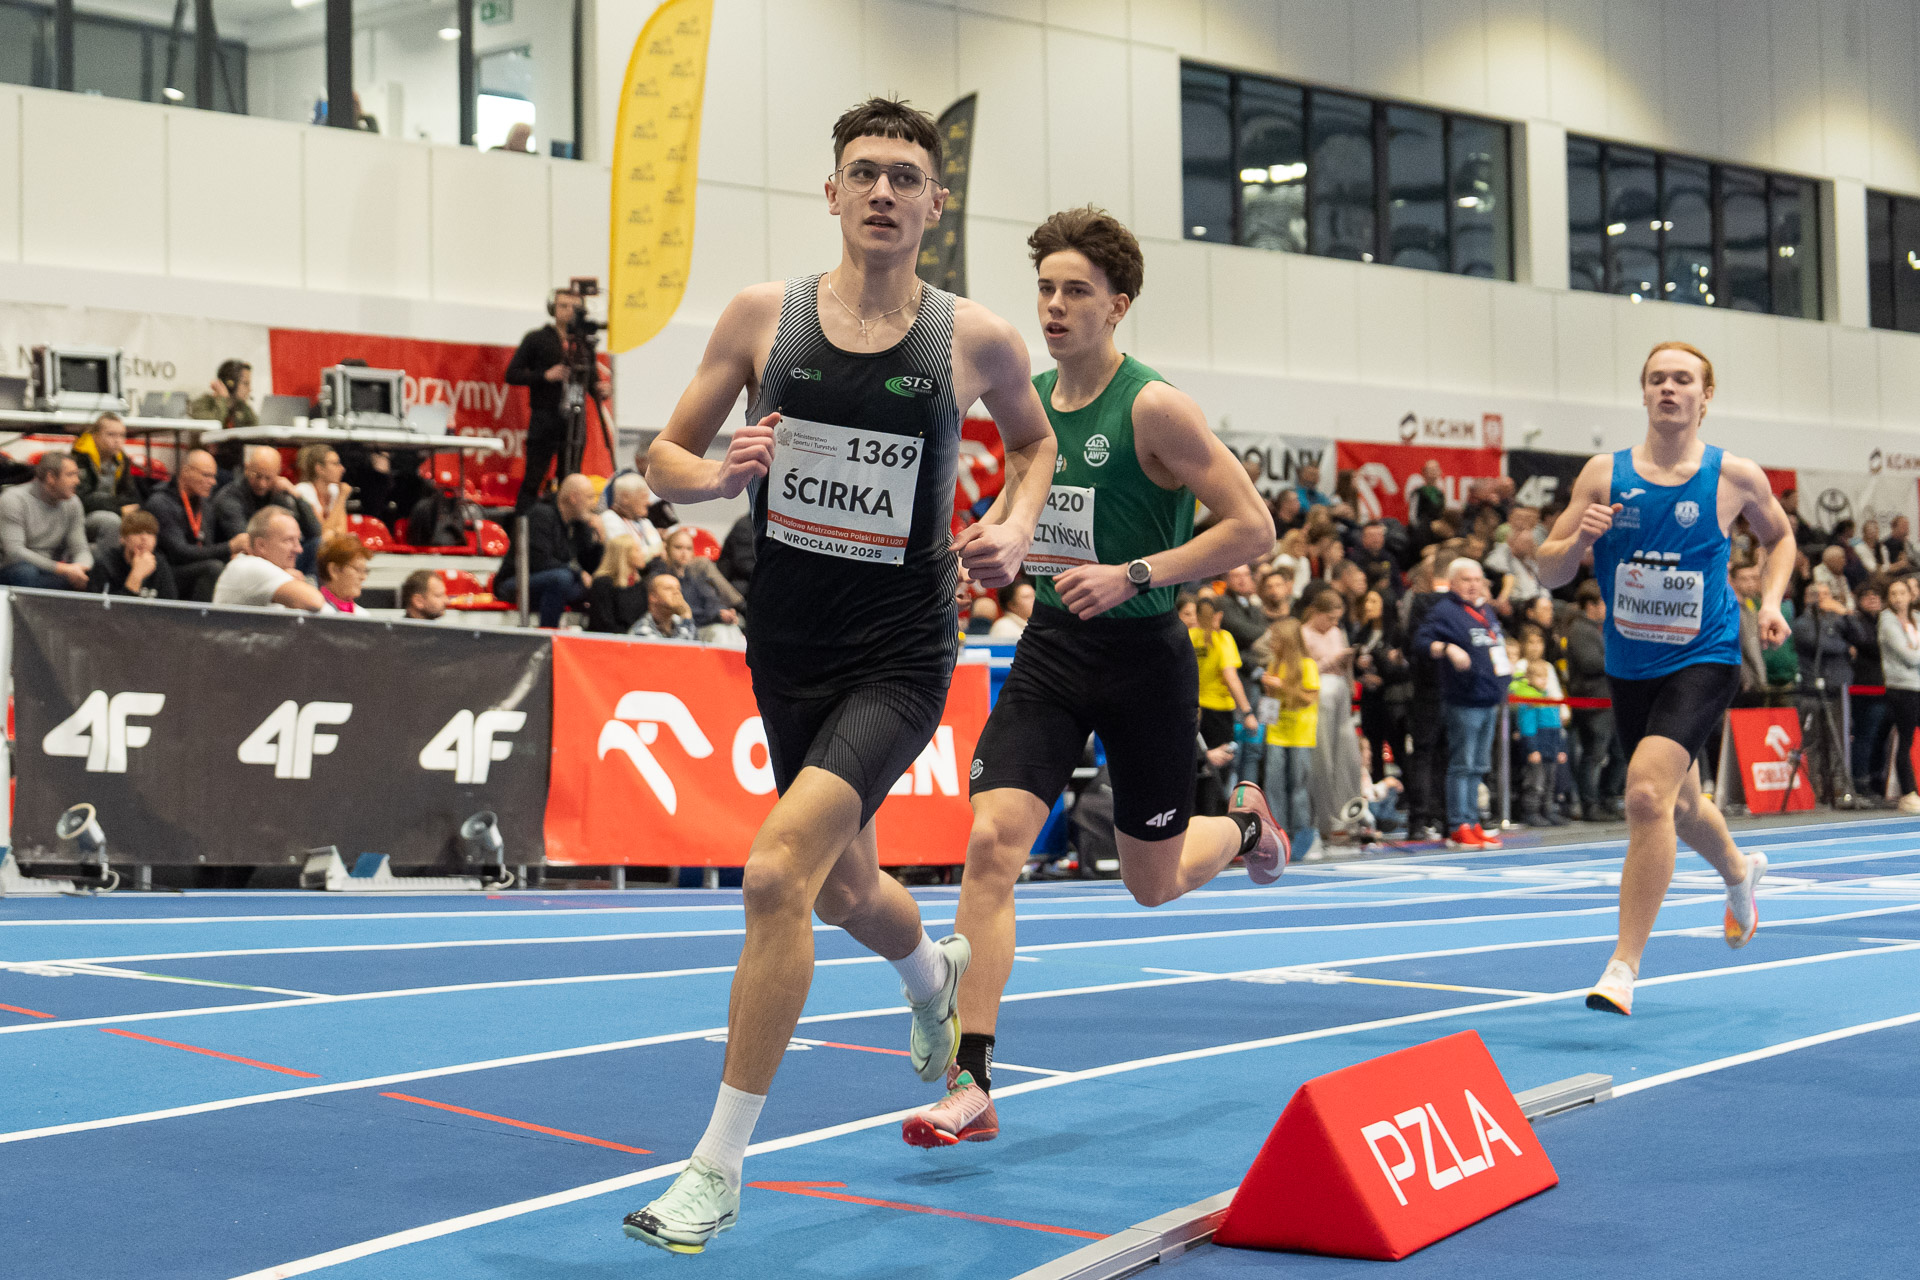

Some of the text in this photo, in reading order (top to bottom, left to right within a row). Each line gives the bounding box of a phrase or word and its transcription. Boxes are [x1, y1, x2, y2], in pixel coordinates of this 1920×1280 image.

[901, 376, 932, 389] STS
[793, 438, 810, 449] Sportu
[814, 442, 838, 452] Turystyki
[794, 432, 827, 443] Ministerstwo
[846, 437, 918, 469] 1369
[782, 467, 894, 518] ŚCIRKA
[783, 518, 806, 530] Halowe
[807, 524, 849, 538] Mistrzostwa
[850, 532, 872, 543] Polski
[872, 535, 886, 544] U18
[890, 538, 904, 546] U20
[783, 530, 882, 559] WROCŁAW 2025
[1034, 522, 1091, 550] CZYŃSKI
[1663, 576, 1696, 590] 809
[1617, 593, 1699, 618] RYNKIEWICZ
[42, 690, 166, 772] 4F
[237, 700, 353, 779] 4F
[418, 709, 528, 784] 4F
[1145, 808, 1177, 827] 4F
[1360, 1088, 1523, 1207] PZLA
